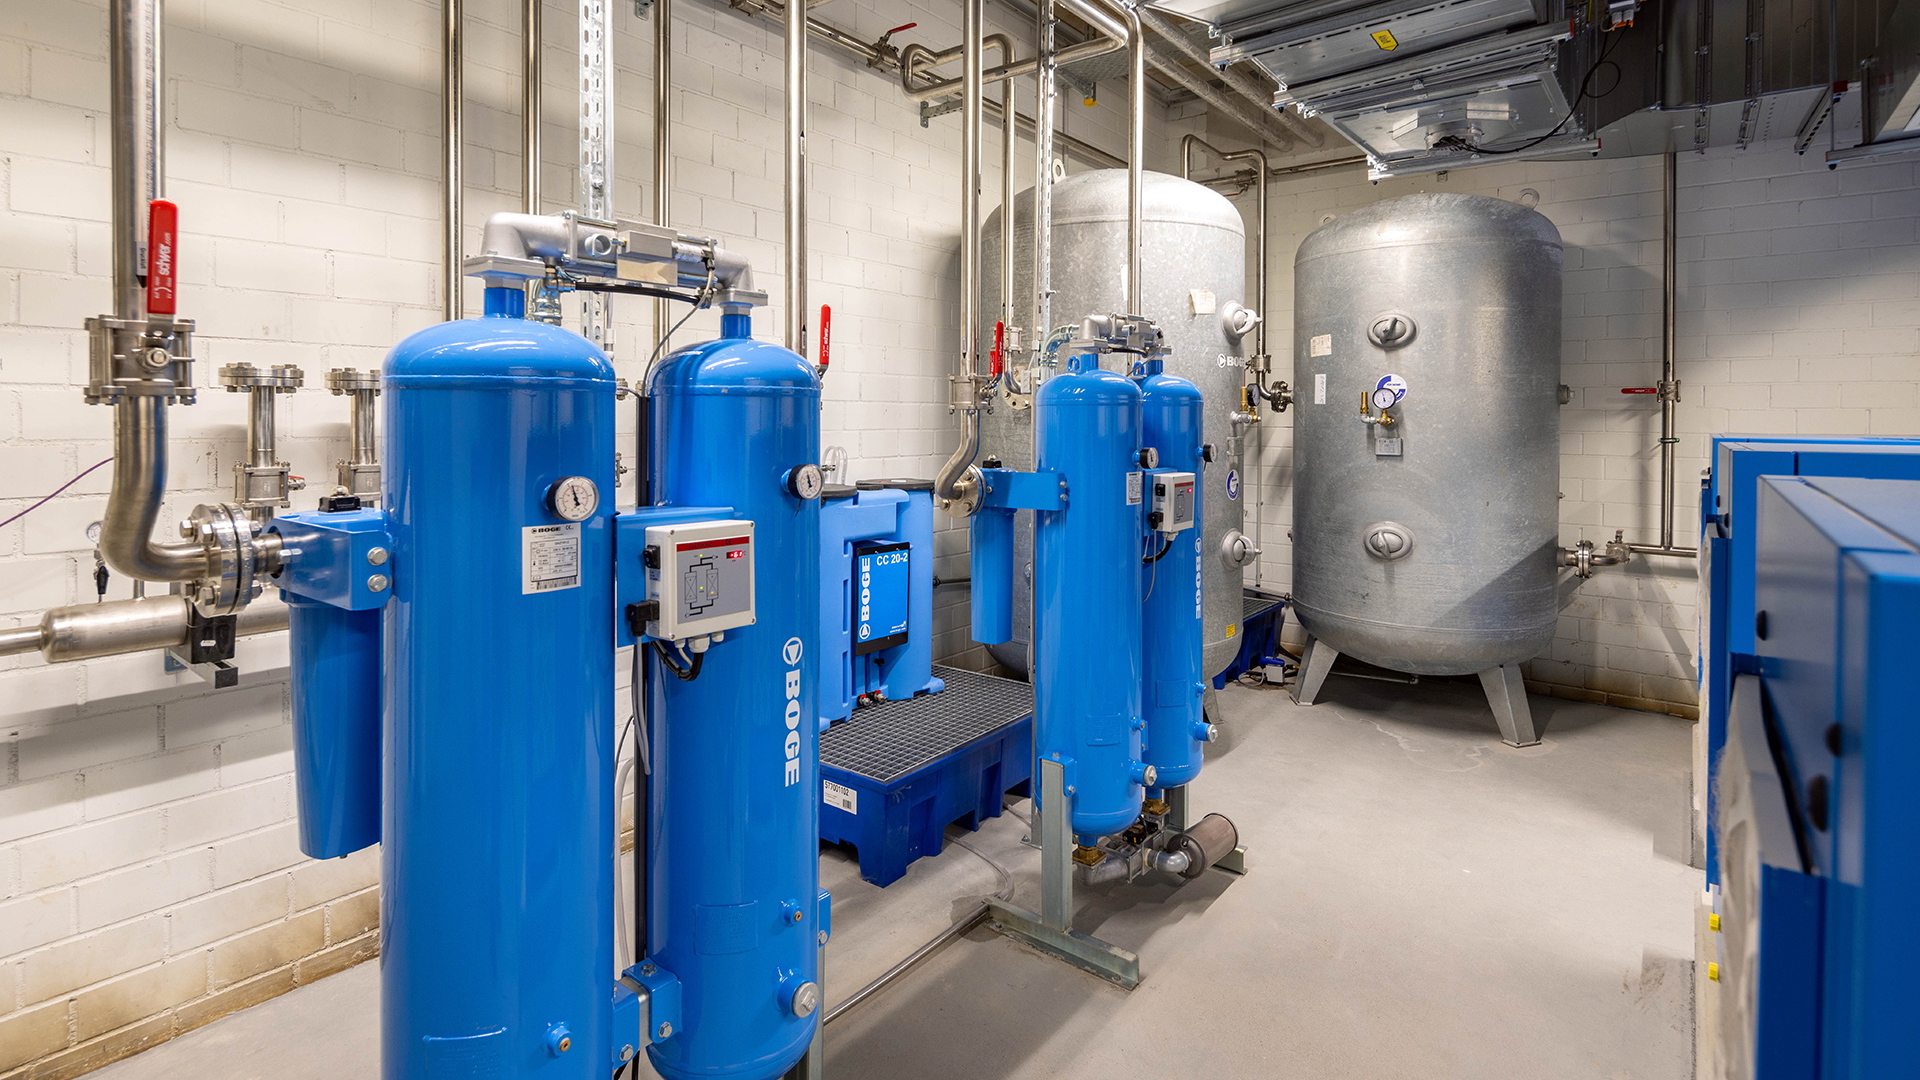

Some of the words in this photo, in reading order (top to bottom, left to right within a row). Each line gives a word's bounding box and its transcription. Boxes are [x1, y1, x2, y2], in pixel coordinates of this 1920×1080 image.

[861, 557, 870, 621] BOGE
[876, 554, 889, 566] CC
[890, 552, 908, 564] 20-2
[784, 669, 800, 787] BOGE
